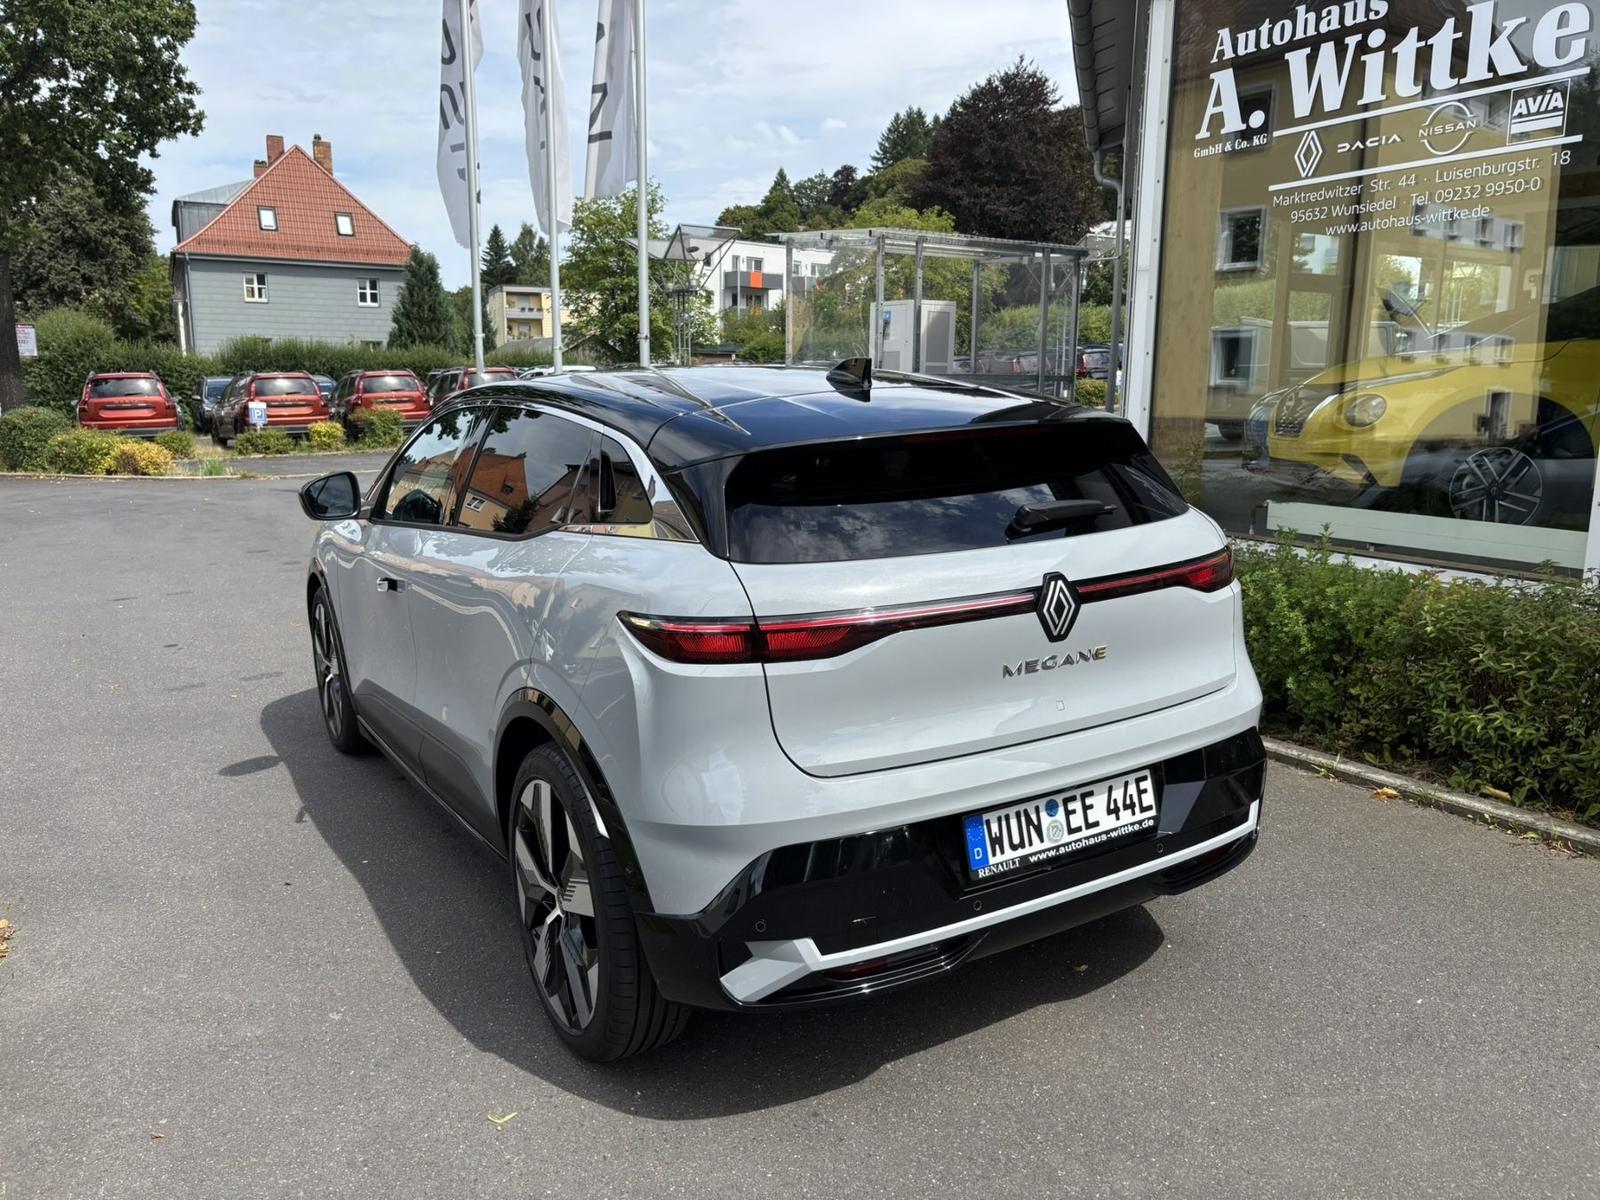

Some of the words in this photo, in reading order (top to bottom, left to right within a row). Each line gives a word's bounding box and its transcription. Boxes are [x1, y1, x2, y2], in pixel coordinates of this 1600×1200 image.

[1210, 0, 1389, 64] Autohaus
[1195, 68, 1266, 141] A.
[1284, 0, 1590, 119] Wittke
[1194, 143, 1222, 158] GmbH
[1224, 140, 1233, 152] &
[1235, 137, 1250, 150] Co.
[1252, 133, 1268, 146] KG
[1337, 133, 1402, 153] DACIA
[1418, 119, 1477, 138] NISSAN
[1273, 184, 1363, 207] Marktredwitzer
[1370, 178, 1391, 193] Str.
[1398, 173, 1416, 188] 44
[1435, 156, 1541, 183] Luisenburgstr.
[1551, 150, 1571, 166] 18
[1290, 206, 1328, 223] 95632
[1331, 195, 1397, 217] Wunsiedel
[1410, 191, 1432, 206] Tel.
[1435, 184, 1481, 203] 09232
[1485, 176, 1541, 197] 9950-0
[1325, 203, 1490, 236] www.autohaus-wittke.de
[1002, 644, 1107, 679] MEGANE
[985, 805, 1045, 858] WUN
[1062, 790, 1100, 836] EE
[1106, 774, 1154, 821] 44E
[974, 847, 983, 860] D
[978, 857, 1021, 879] RENAULT
[1029, 817, 1155, 864] www.autohaus-wittke.de
